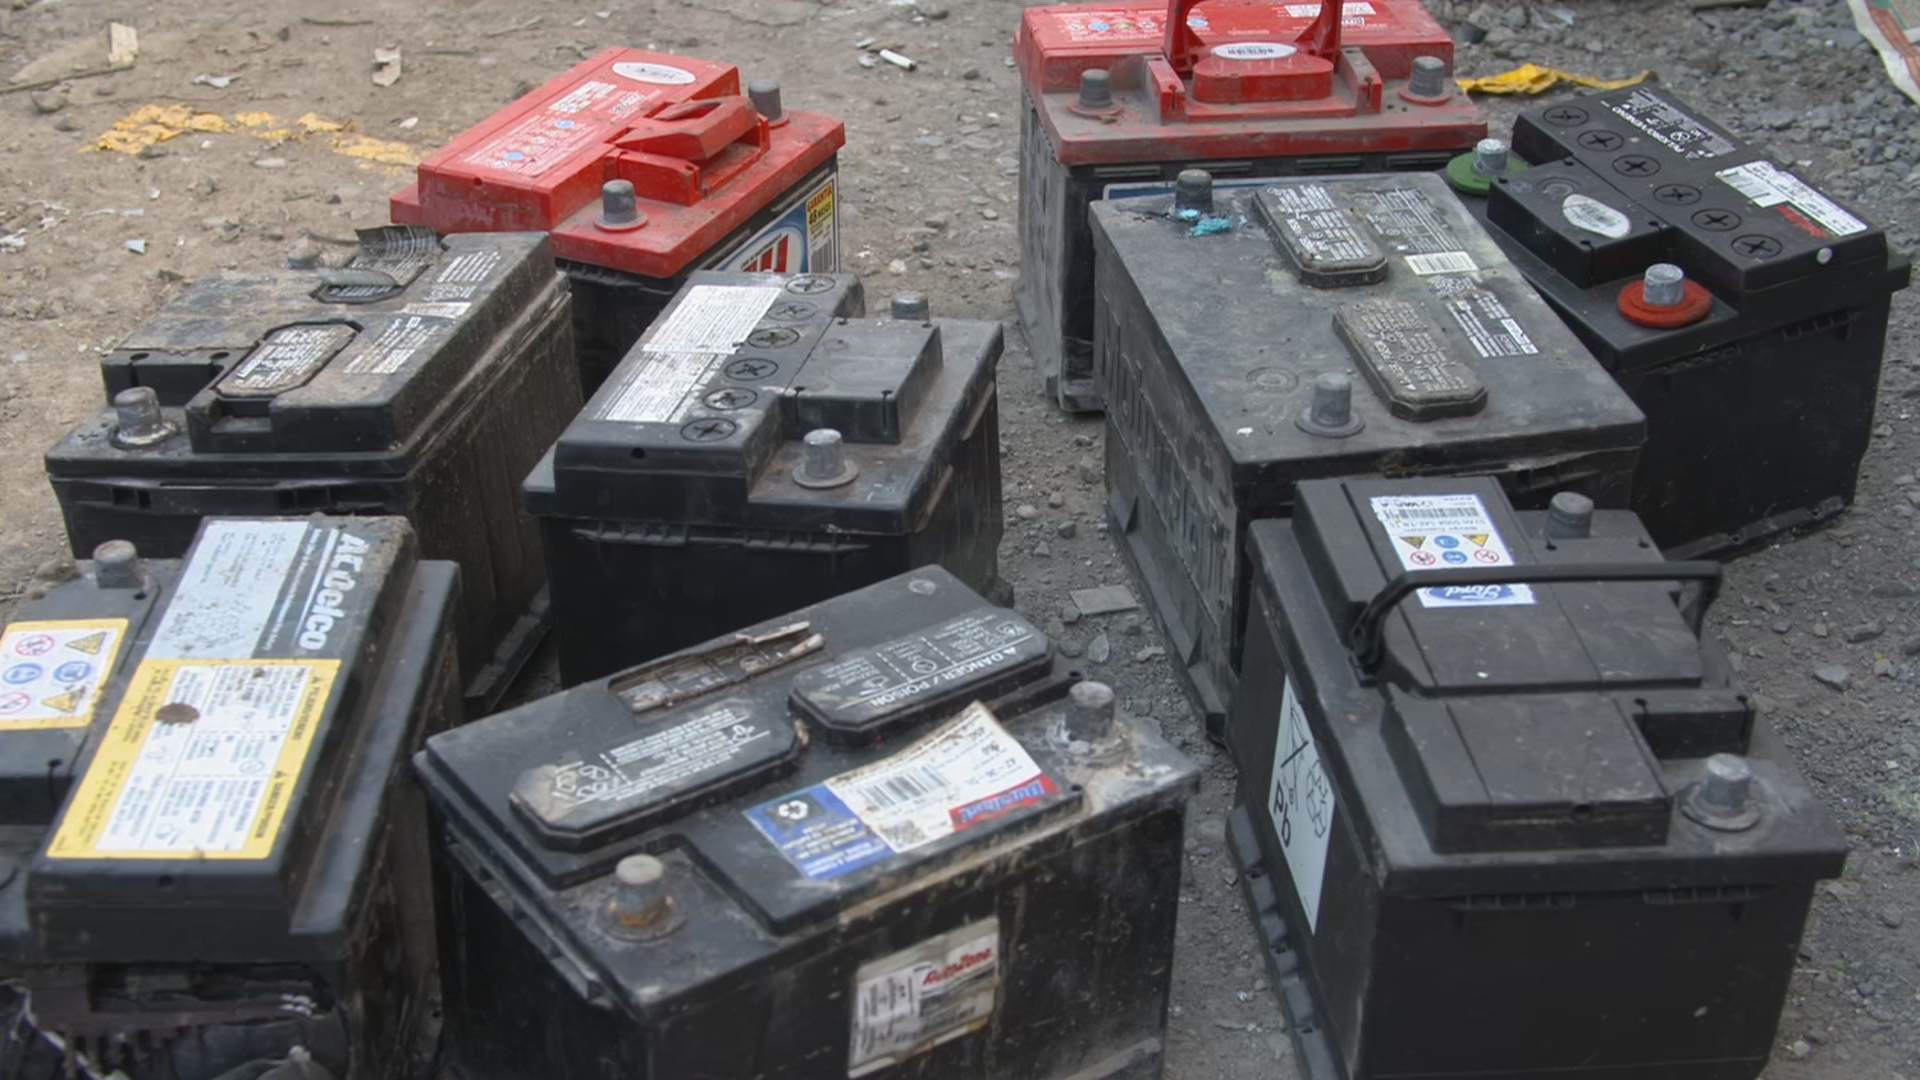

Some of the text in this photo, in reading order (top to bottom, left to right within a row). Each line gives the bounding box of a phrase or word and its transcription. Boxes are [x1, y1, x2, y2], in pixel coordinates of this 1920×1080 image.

[1444, 582, 1503, 599] Ford
[941, 651, 1004, 681] DANGER
[869, 681, 931, 707] POISON
